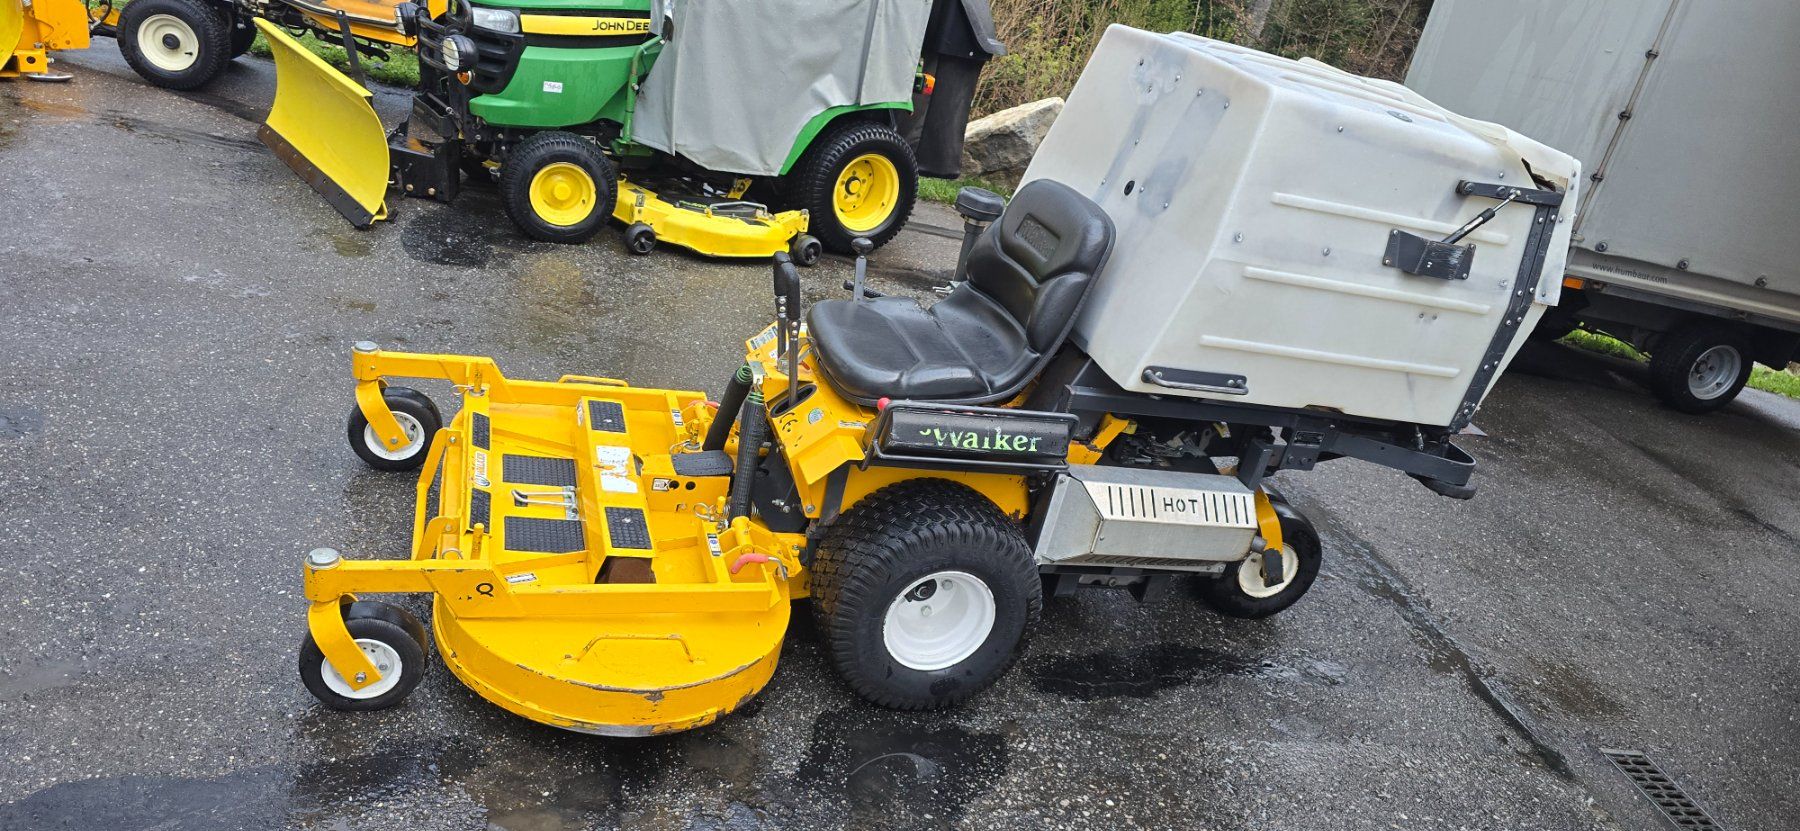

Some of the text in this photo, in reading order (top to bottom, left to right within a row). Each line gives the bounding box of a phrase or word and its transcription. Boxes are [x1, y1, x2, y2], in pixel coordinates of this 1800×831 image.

[592, 20, 650, 31] JOHN DEE
[1592, 263, 1668, 284] www.humbaur.com
[1163, 497, 1198, 514] HOT
